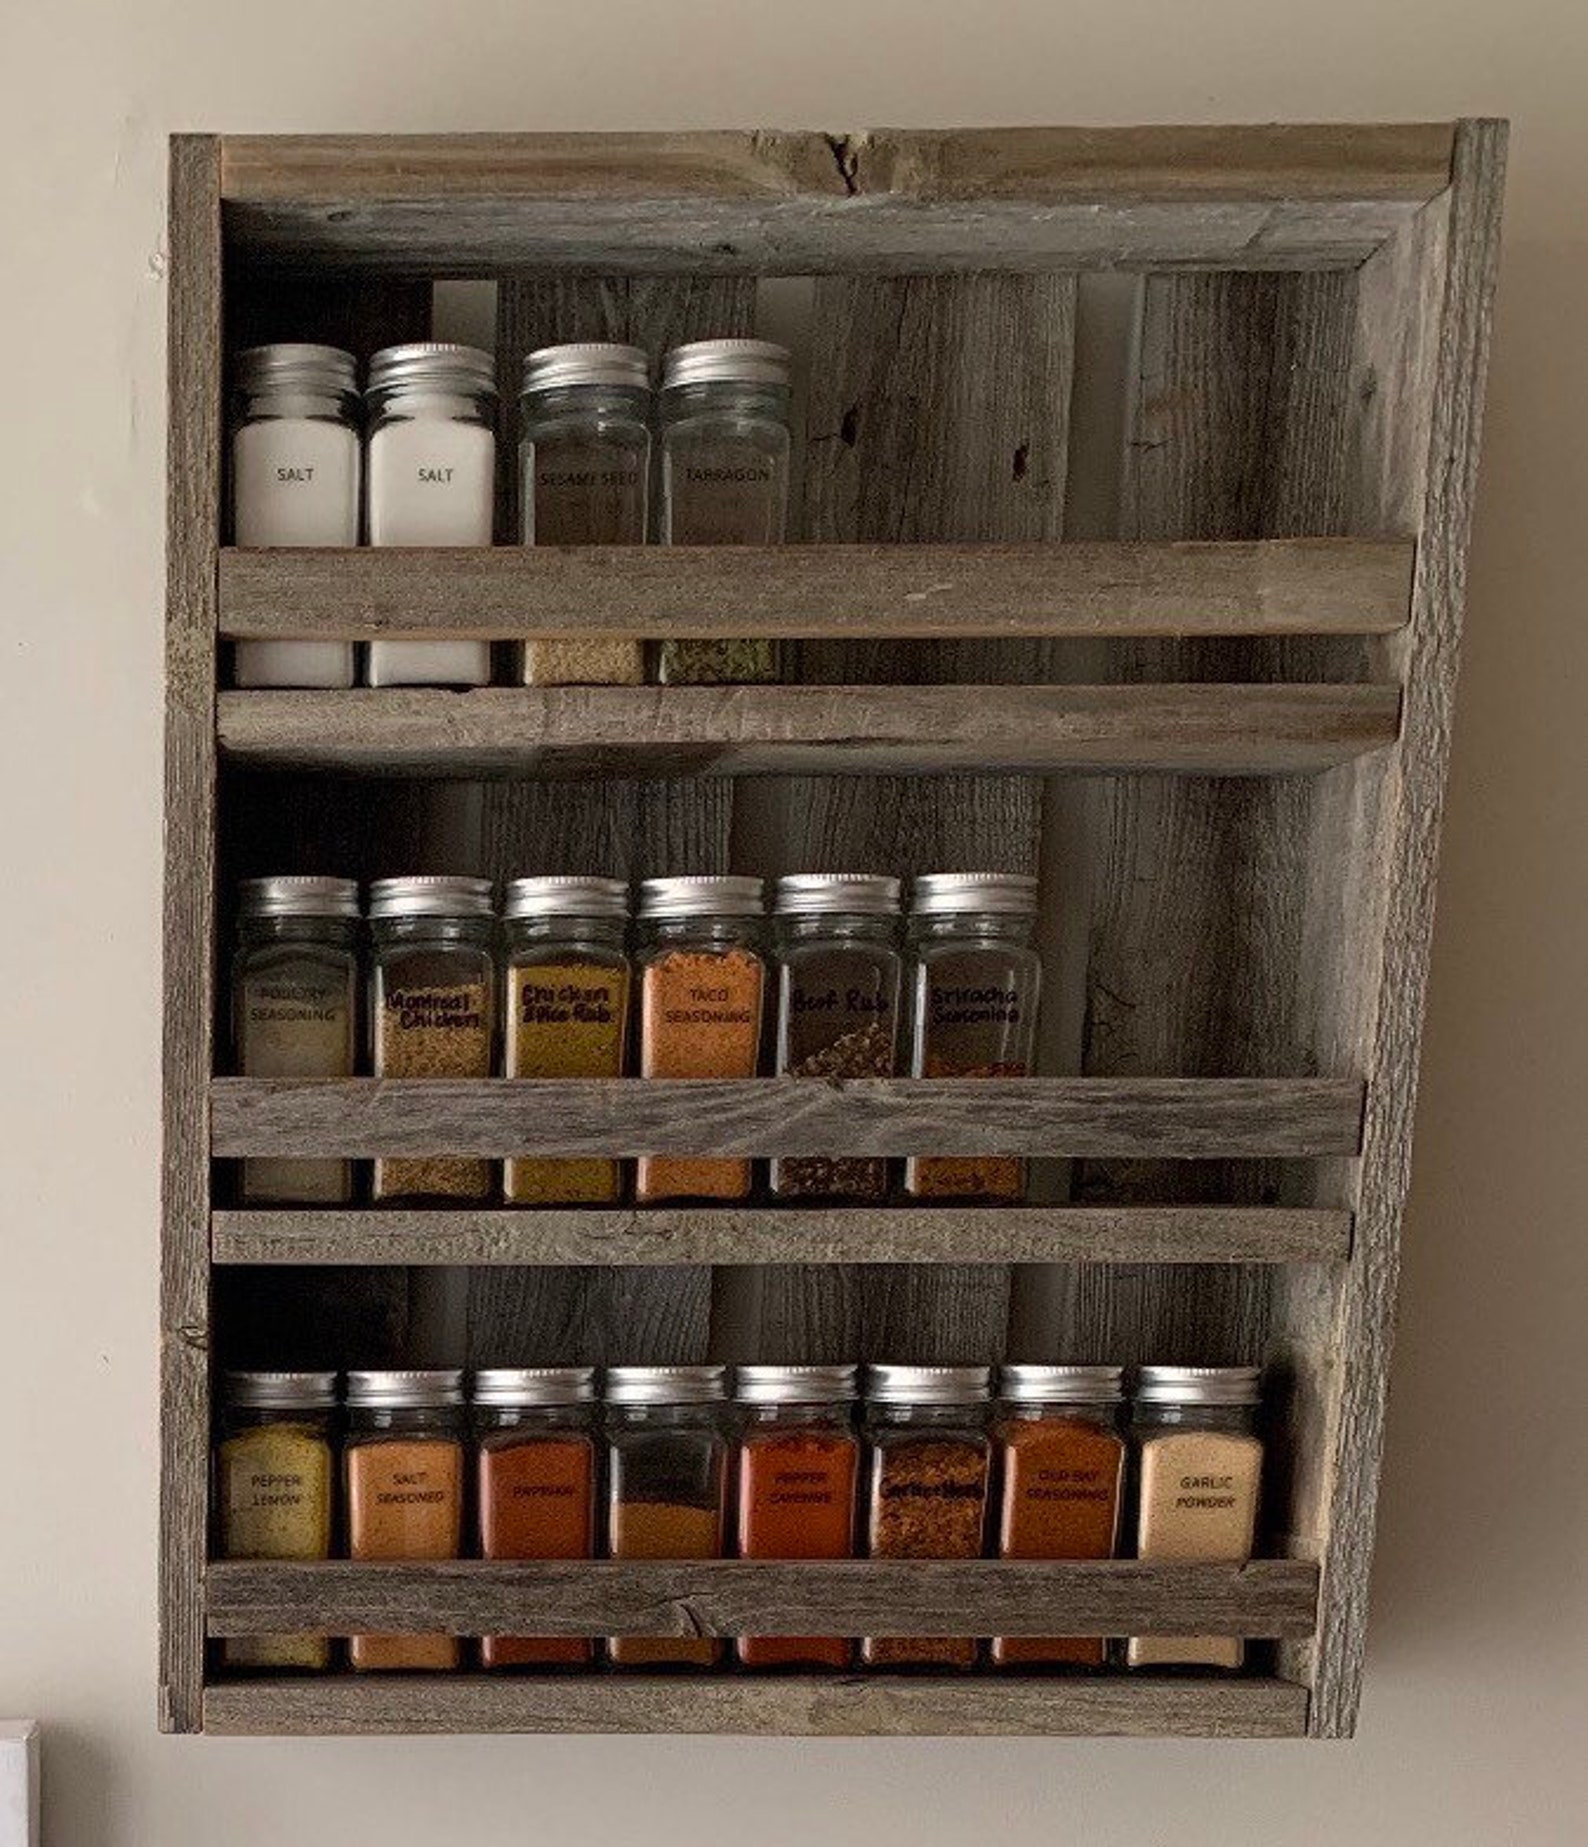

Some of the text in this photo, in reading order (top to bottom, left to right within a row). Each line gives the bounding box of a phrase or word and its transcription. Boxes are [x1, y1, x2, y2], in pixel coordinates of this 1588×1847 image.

[276, 467, 315, 481] SALT
[417, 467, 454, 482] SALT
[685, 467, 770, 482] TARRAGON
[689, 988, 729, 1002] TACO
[250, 1008, 336, 1022] SEASONING
[665, 1009, 751, 1023] SEASONING
[251, 1474, 300, 1487] PEPPER
[392, 1471, 428, 1485] SALT
[1180, 1475, 1234, 1490] GARLIC
[251, 1494, 300, 1507] LEMON
[375, 1491, 444, 1505] SEASONED
[1027, 1487, 1109, 1501] SEASONING
[1175, 1496, 1236, 1510] POWDER
